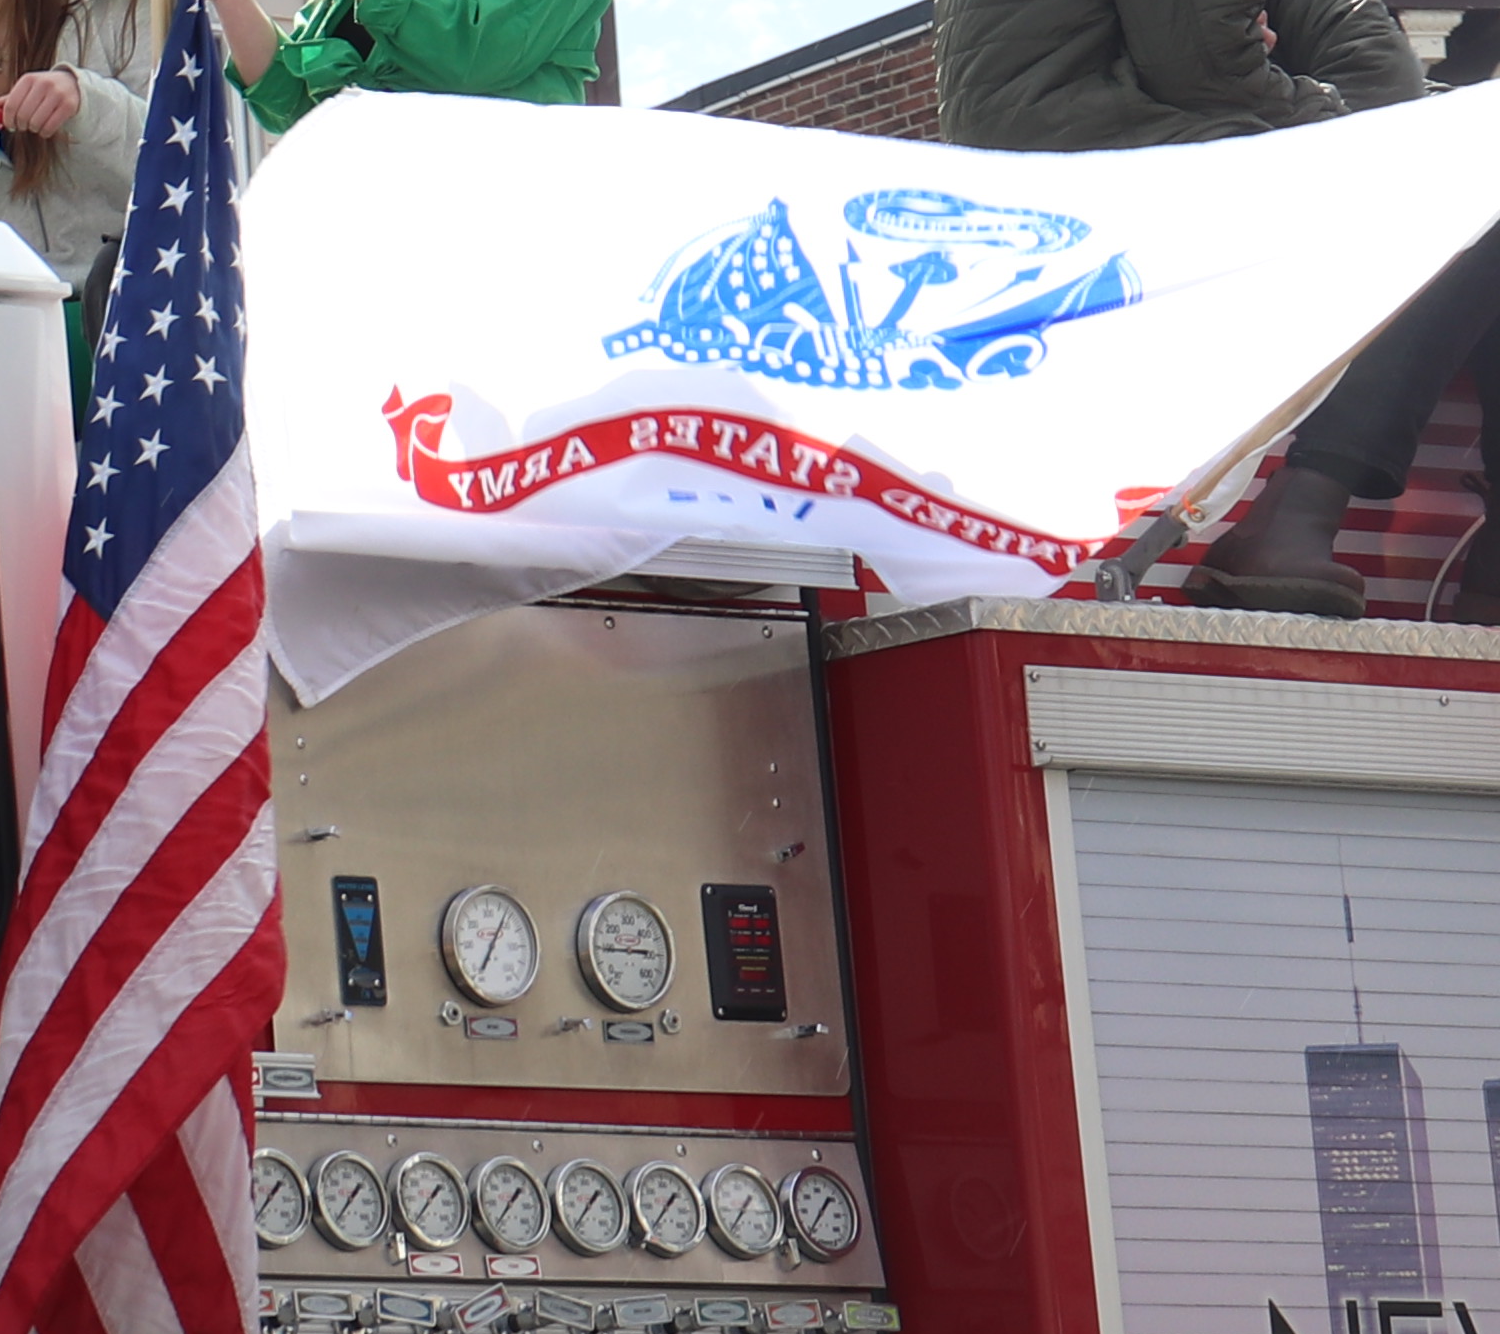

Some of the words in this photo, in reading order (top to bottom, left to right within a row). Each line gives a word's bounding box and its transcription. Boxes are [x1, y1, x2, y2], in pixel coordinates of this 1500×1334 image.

[621, 915, 636, 926] 300
[605, 924, 620, 935] 200
[639, 967, 654, 979] 600
